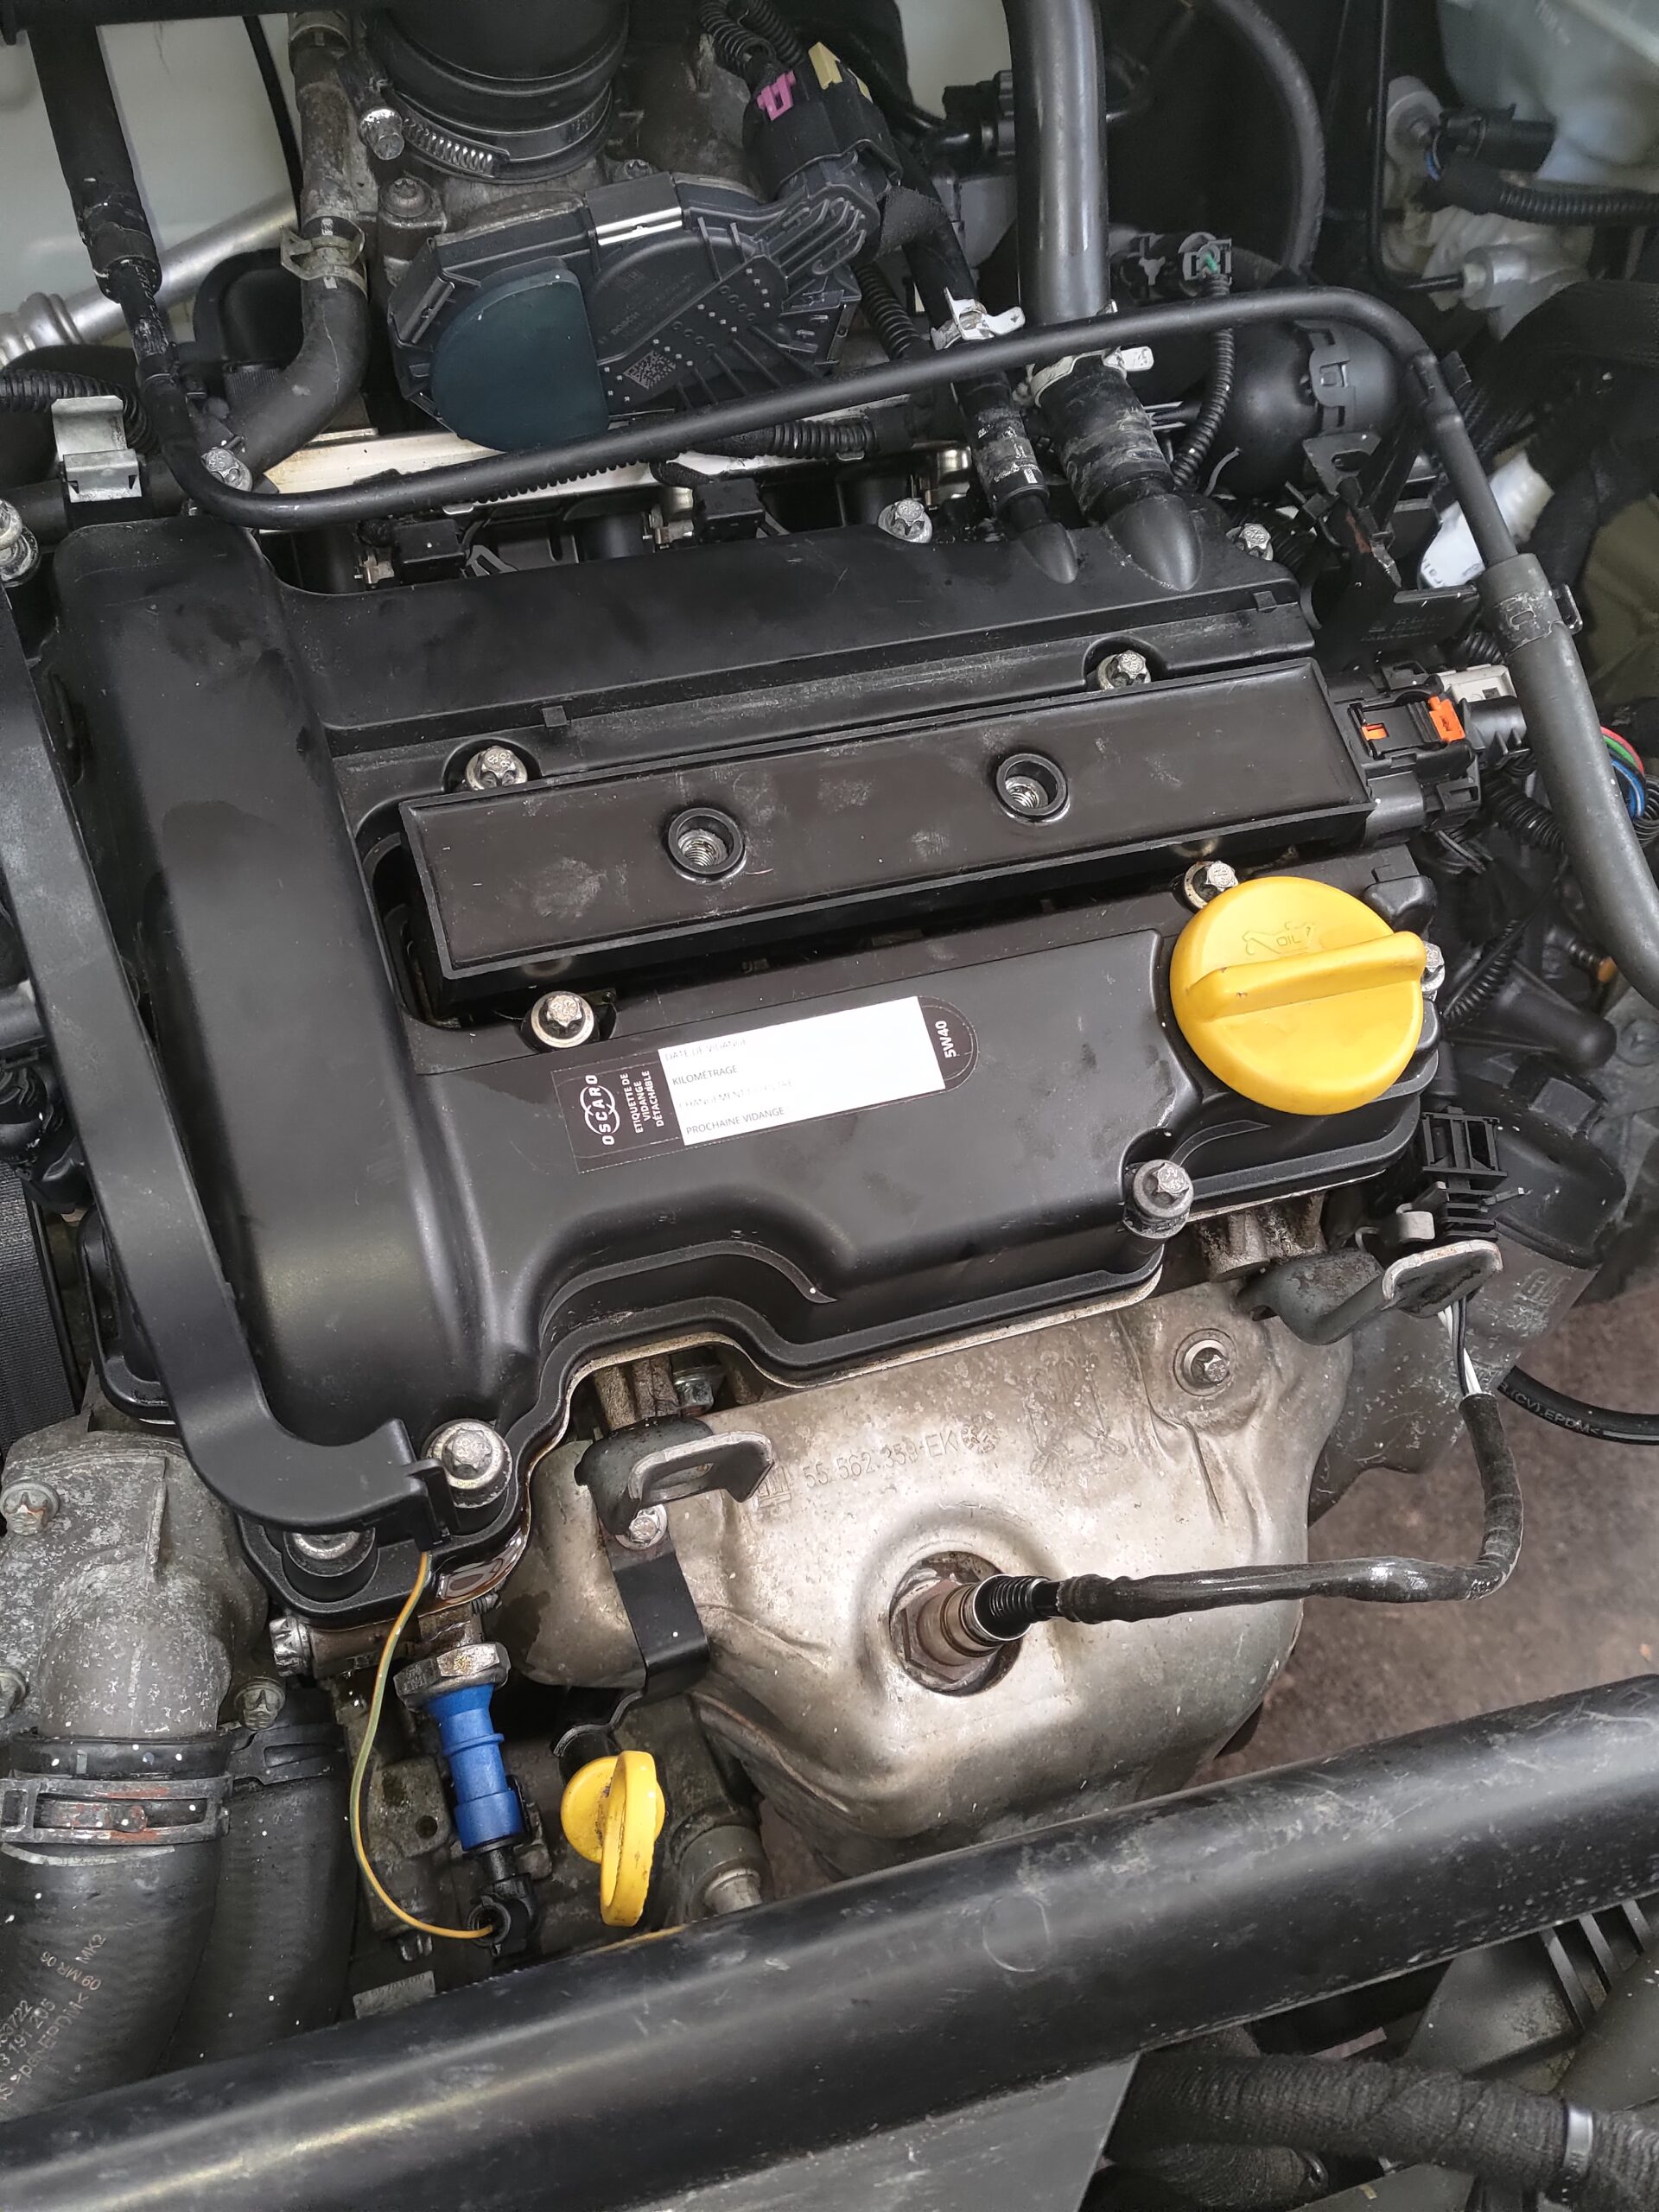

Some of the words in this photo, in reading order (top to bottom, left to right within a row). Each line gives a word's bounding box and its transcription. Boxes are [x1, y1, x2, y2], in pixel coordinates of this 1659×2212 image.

[1276, 935, 1301, 947] OIL
[934, 1020, 957, 1058] 5W40
[620, 1072, 631, 1086] DE
[671, 1065, 739, 1086] KILOMÉTRAGE
[585, 1074, 615, 1146] OSCARO
[623, 1085, 645, 1134] ETIQUETTE
[633, 1080, 652, 1122] VIDANGE
[641, 1070, 664, 1128] DÉTACHABLE
[685, 1116, 741, 1135] PROCHAINE
[742, 1106, 785, 1123] VIDANGE
[74, 1934, 107, 1964] MK2
